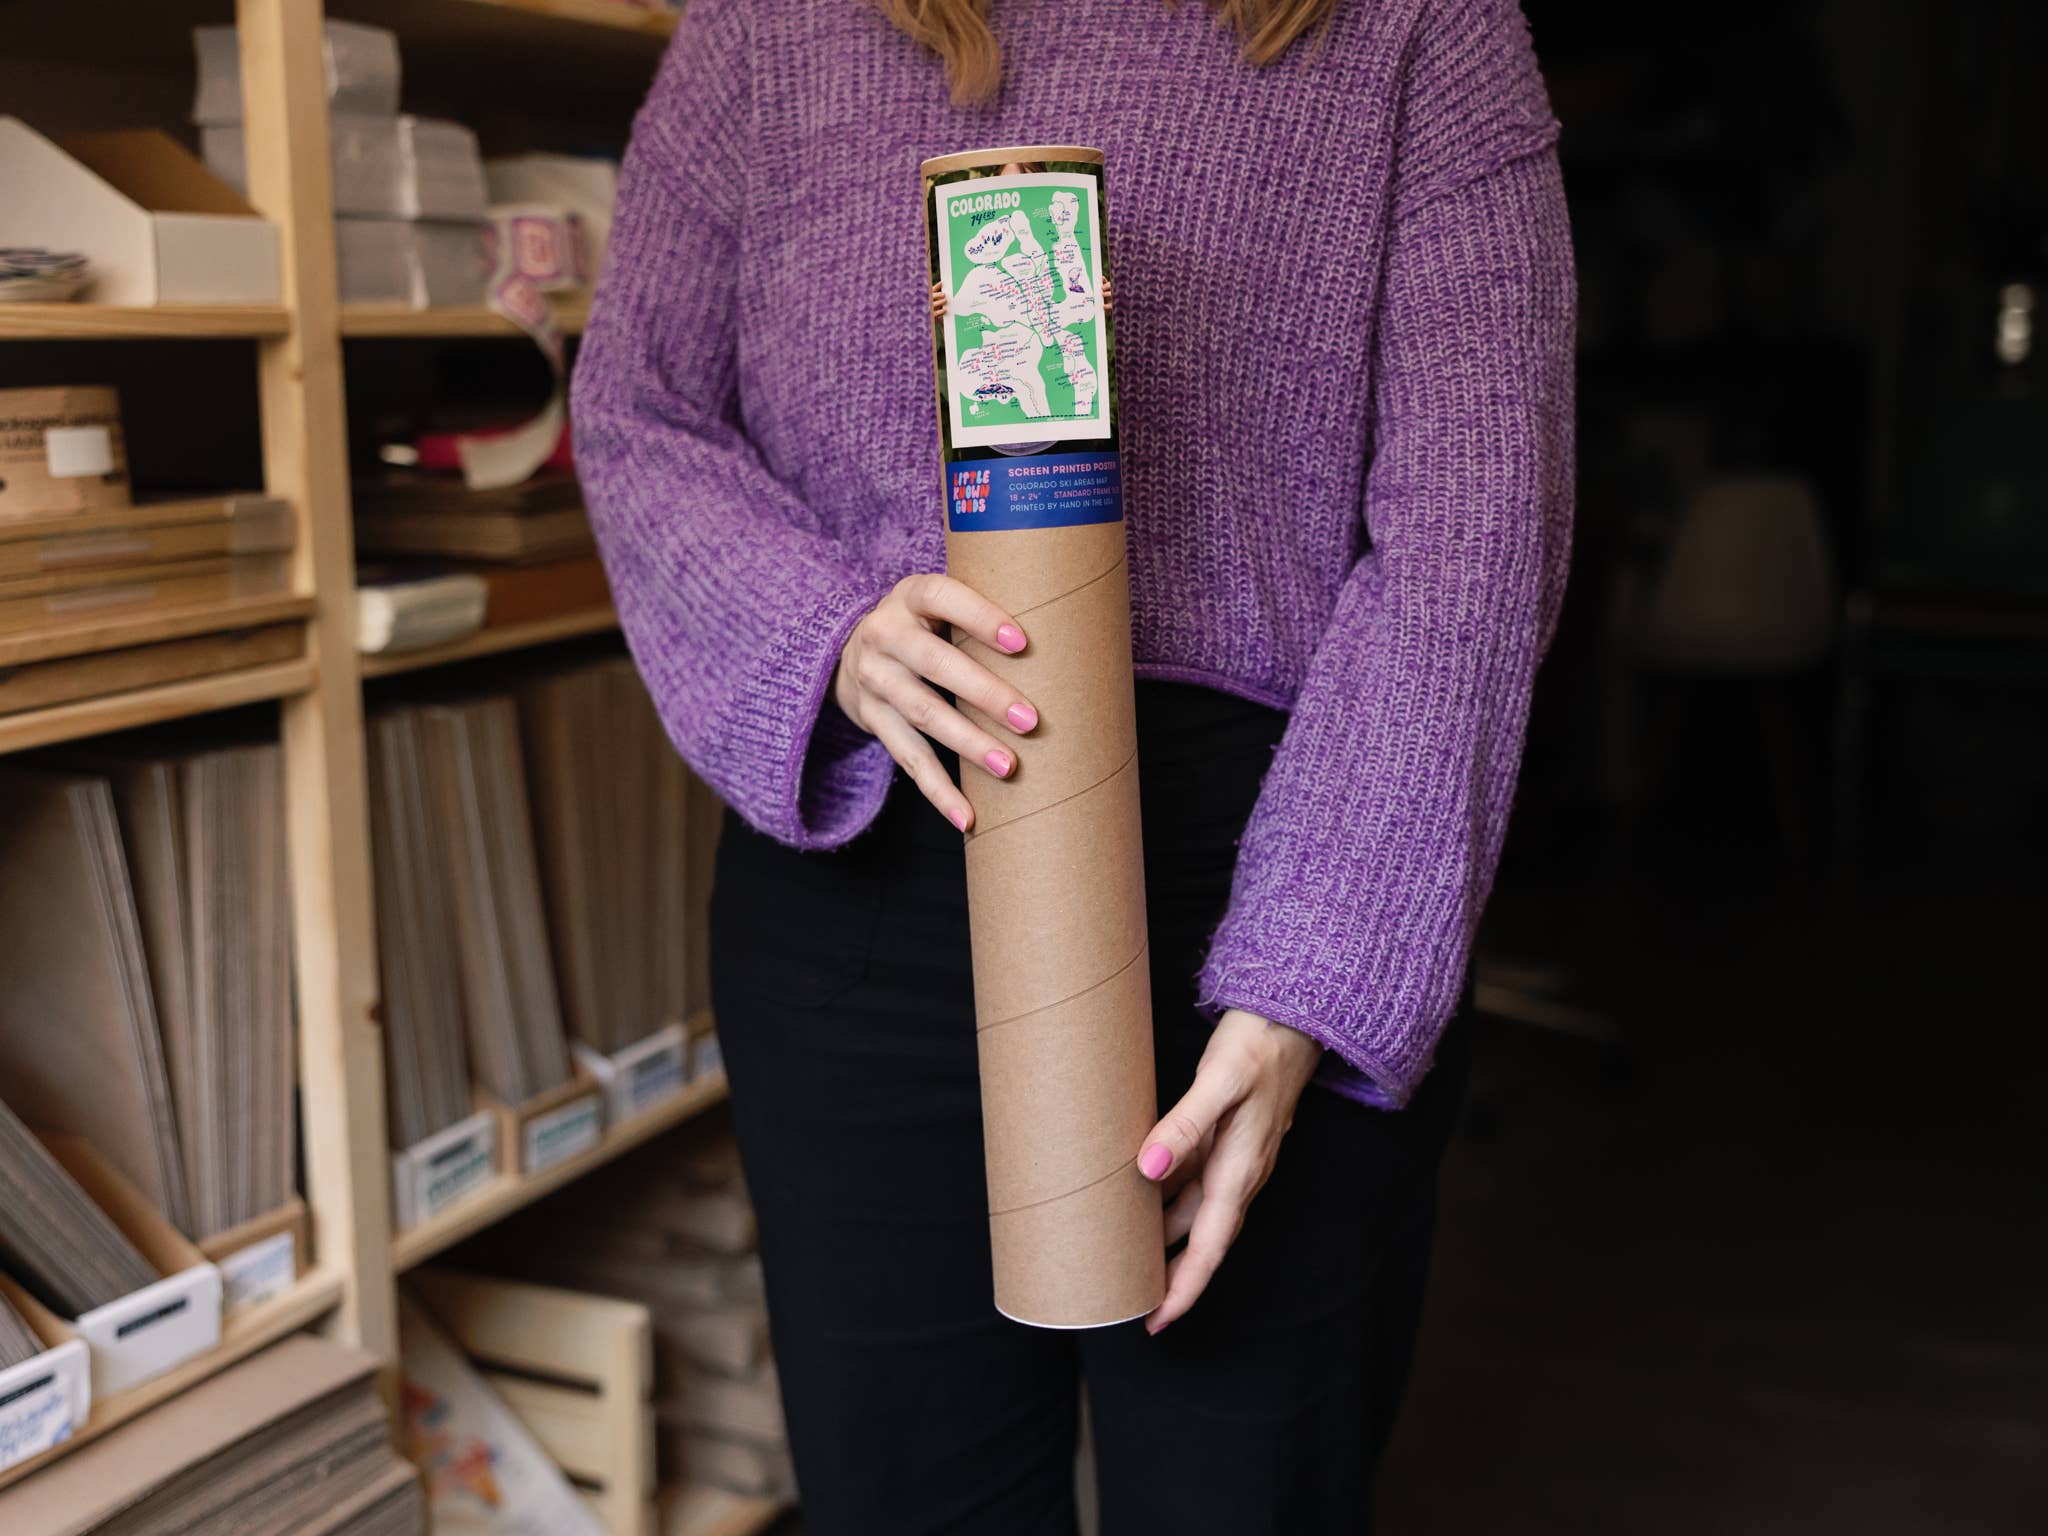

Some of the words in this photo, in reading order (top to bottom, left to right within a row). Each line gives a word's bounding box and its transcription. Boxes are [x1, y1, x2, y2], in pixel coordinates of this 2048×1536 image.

[950, 191, 1021, 218] COLORADO
[953, 469, 991, 486] LITTLE
[1008, 465, 1050, 477] SCREEN
[1052, 463, 1092, 474] PRINTED
[1008, 480, 1058, 491] COLORADO
[1059, 479, 1072, 488] SKI
[1073, 478, 1095, 487] AREAS
[953, 484, 991, 501] KNOWN
[1054, 488, 1092, 499] STANDARD
[956, 498, 986, 514] GOODS
[1010, 503, 1045, 512] PRINTED
[1047, 502, 1058, 511] BY
[1059, 500, 1081, 510] HAND
[1082, 499, 1090, 507] IN
[1092, 498, 1103, 506] THE
